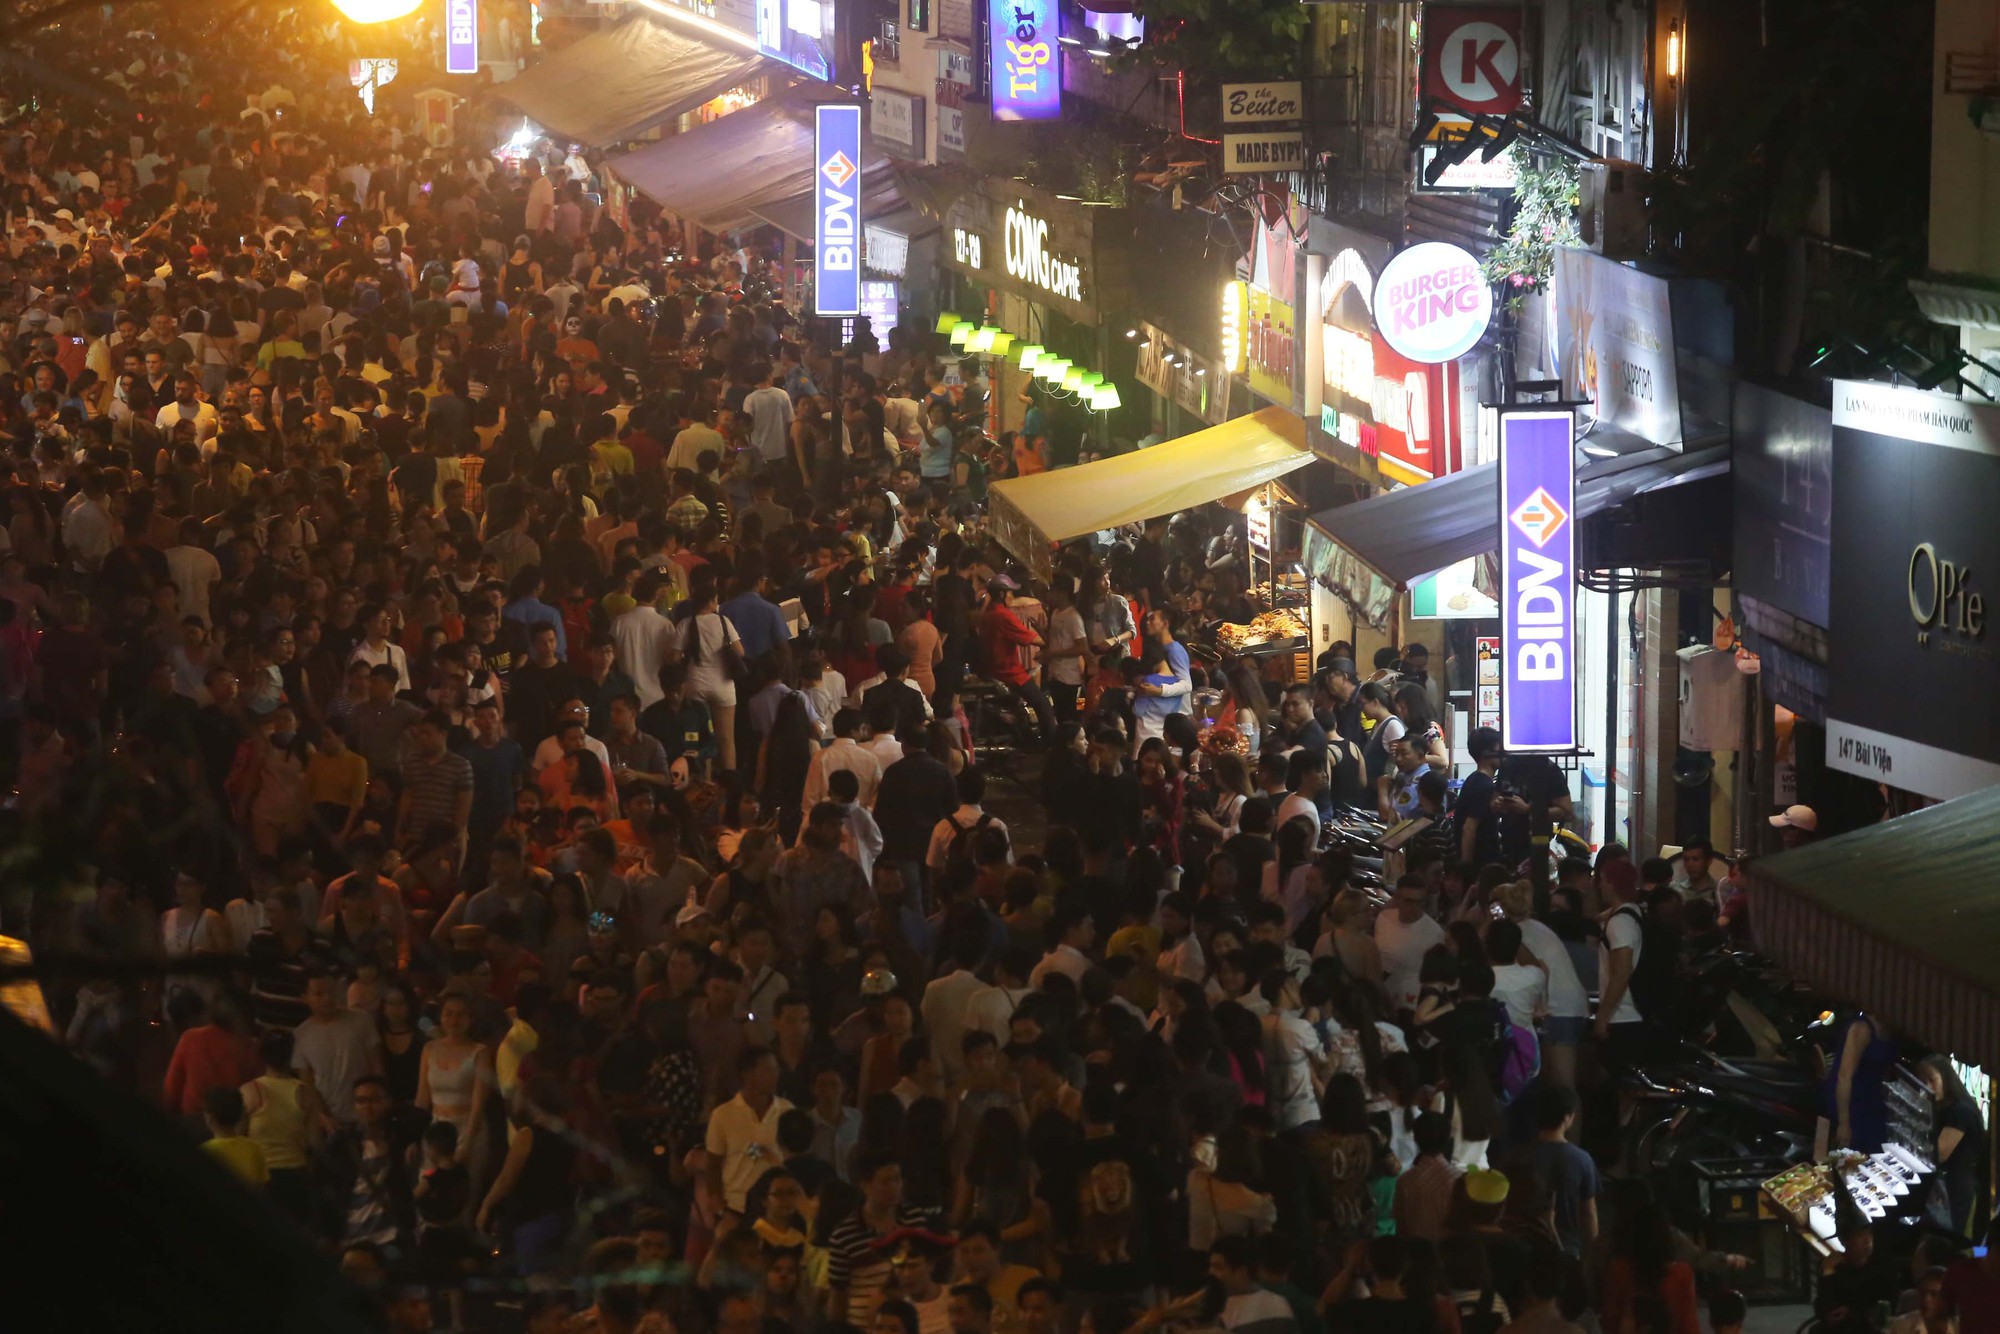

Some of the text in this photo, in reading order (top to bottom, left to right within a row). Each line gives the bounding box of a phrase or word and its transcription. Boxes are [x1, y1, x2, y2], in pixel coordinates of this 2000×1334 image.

[1005, 6, 1050, 99] Tiger
[1461, 39, 1510, 97] K
[1229, 90, 1297, 115] Beuter
[1255, 87, 1272, 98] the
[1236, 142, 1270, 164] MADE
[824, 187, 854, 271] BIDV
[868, 282, 895, 299] SPA
[1389, 264, 1476, 307] BURGER
[1393, 283, 1479, 337] KING
[1622, 359, 1654, 402] SAPPORO
[1845, 396, 1860, 413] LAN
[1517, 547, 1564, 681] BIDV
[1838, 736, 1853, 759] 147
